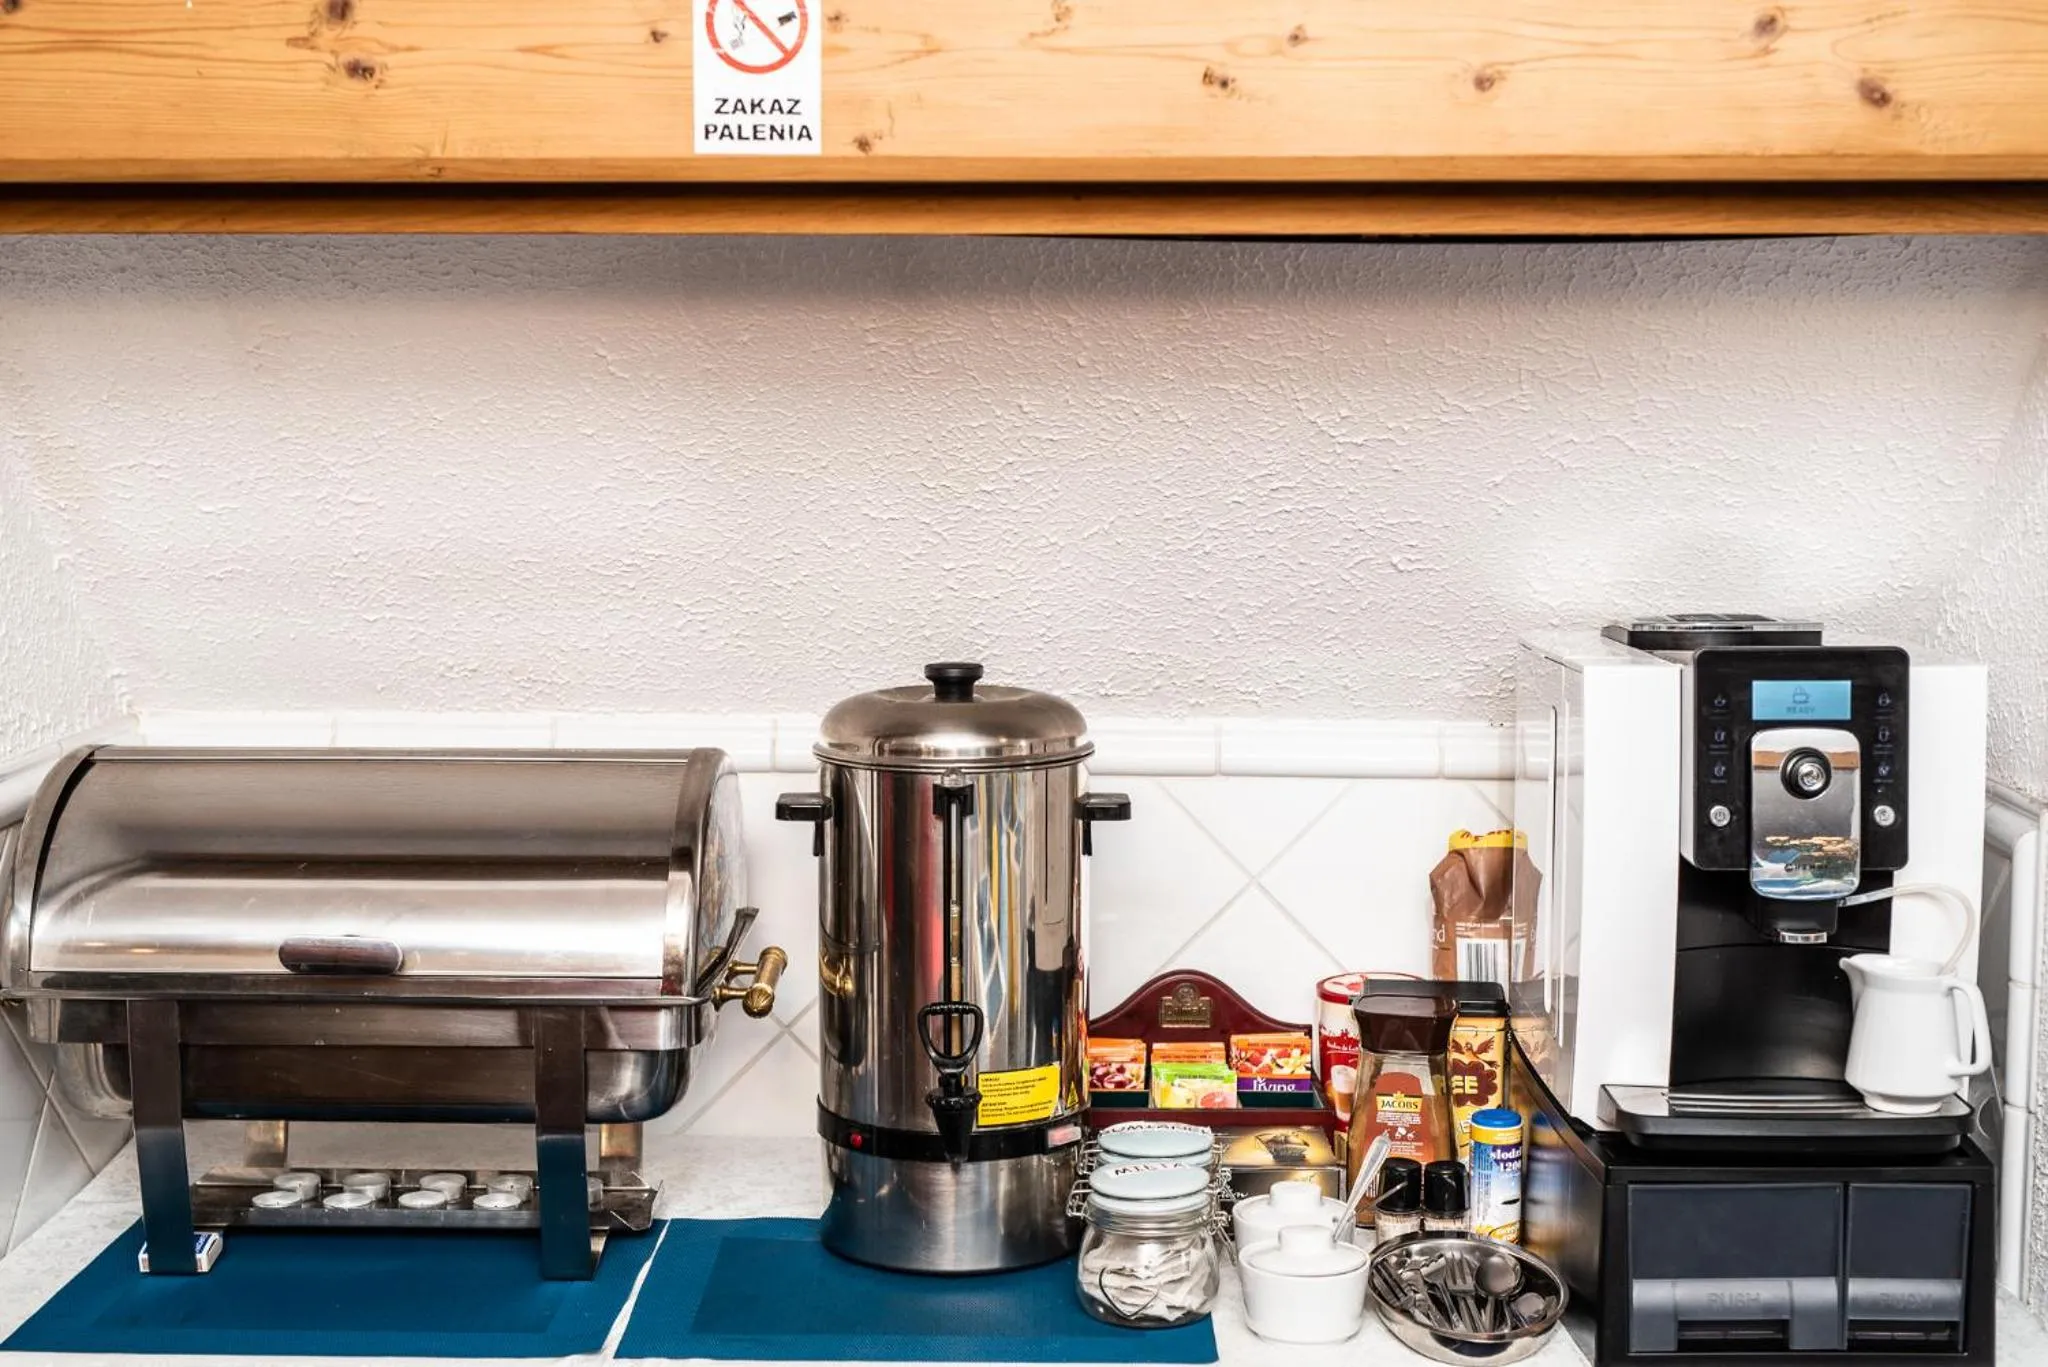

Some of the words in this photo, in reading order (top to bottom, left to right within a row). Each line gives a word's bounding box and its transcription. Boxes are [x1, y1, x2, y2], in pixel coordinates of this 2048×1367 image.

[714, 98, 802, 115] ZAKAZ
[704, 124, 813, 141] PALENIA
[1786, 706, 1816, 714] READY
[1381, 1099, 1418, 1109] JACOBS
